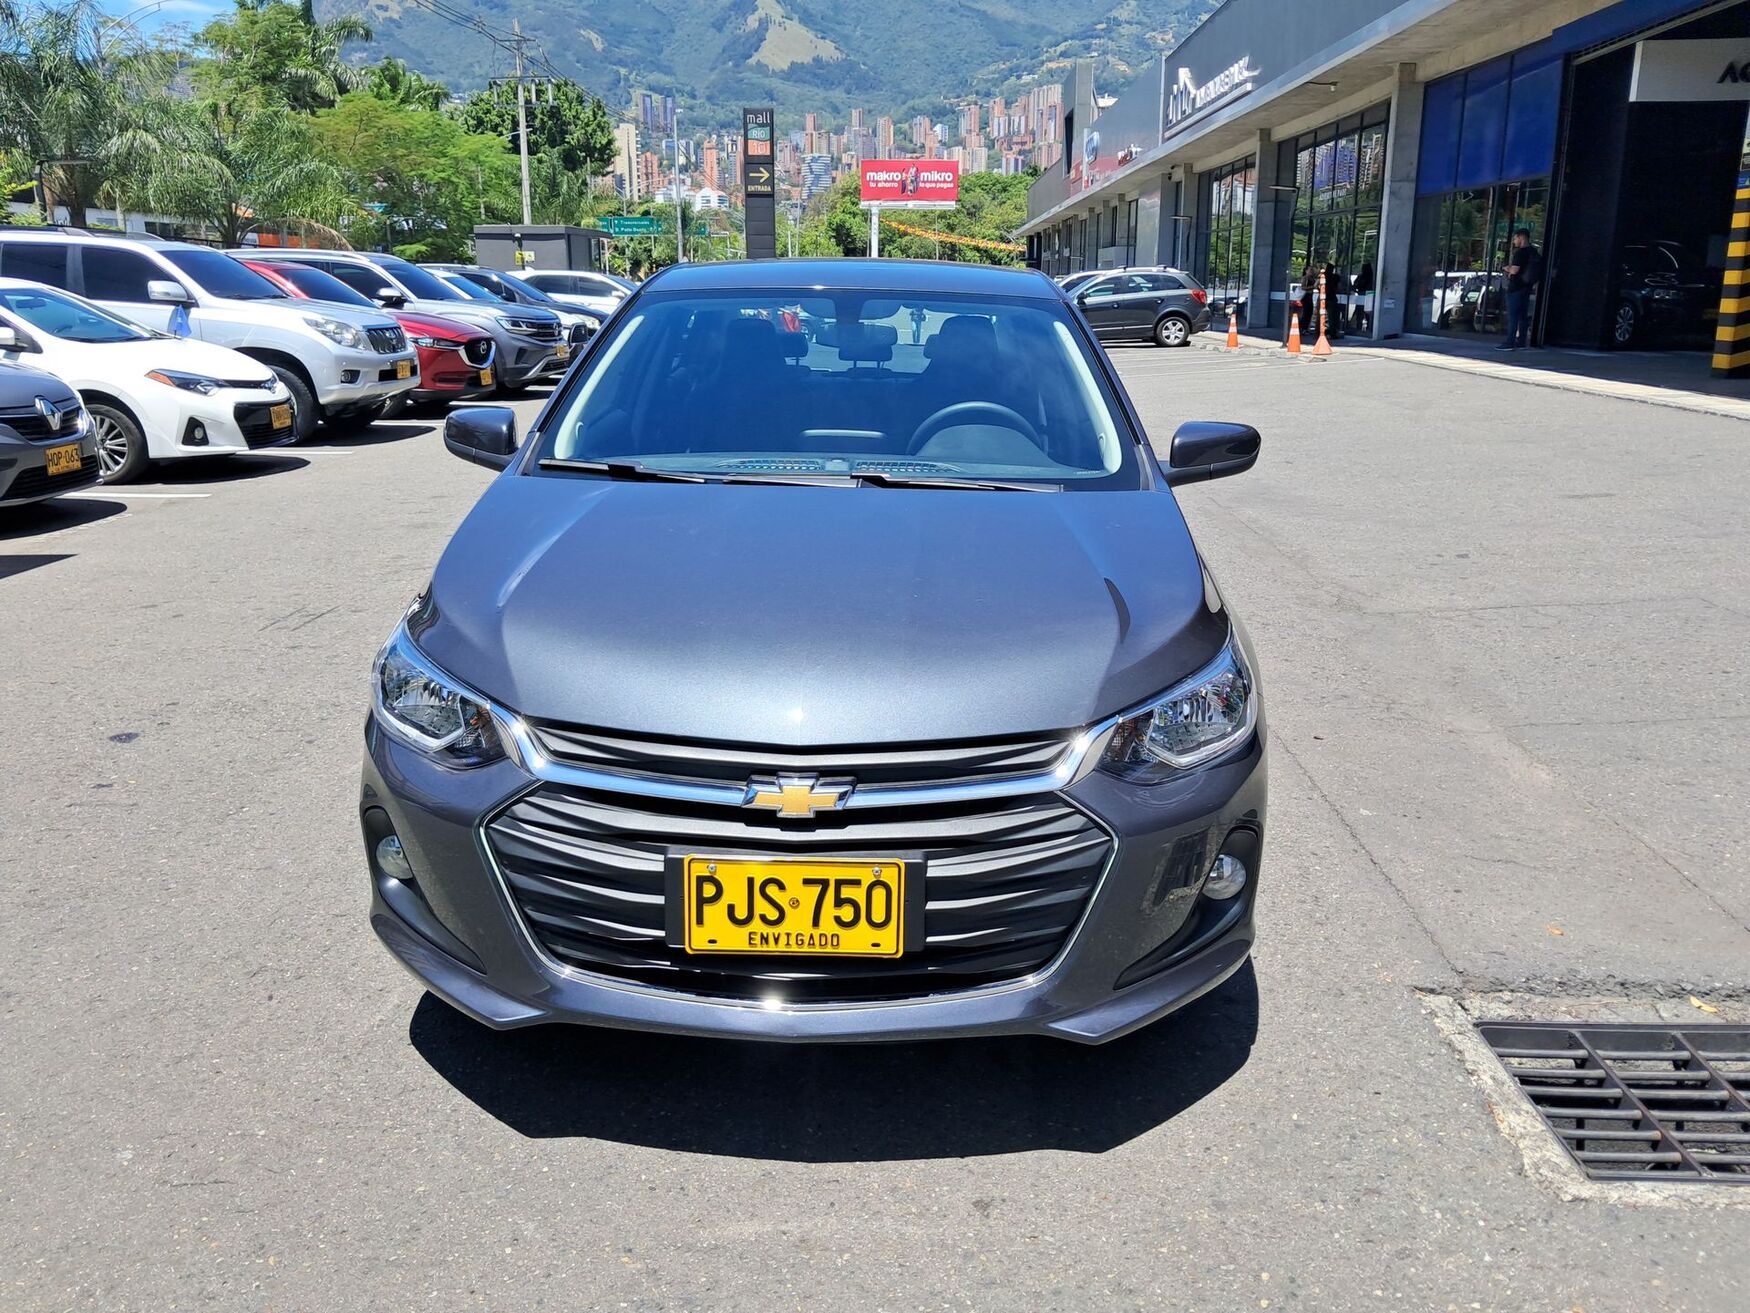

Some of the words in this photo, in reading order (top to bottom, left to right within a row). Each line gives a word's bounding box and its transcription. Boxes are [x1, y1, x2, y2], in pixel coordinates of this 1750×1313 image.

[746, 111, 770, 124] mall
[866, 171, 901, 181] makro
[920, 171, 953, 181] mikro
[748, 932, 841, 948] ENVIGADO
